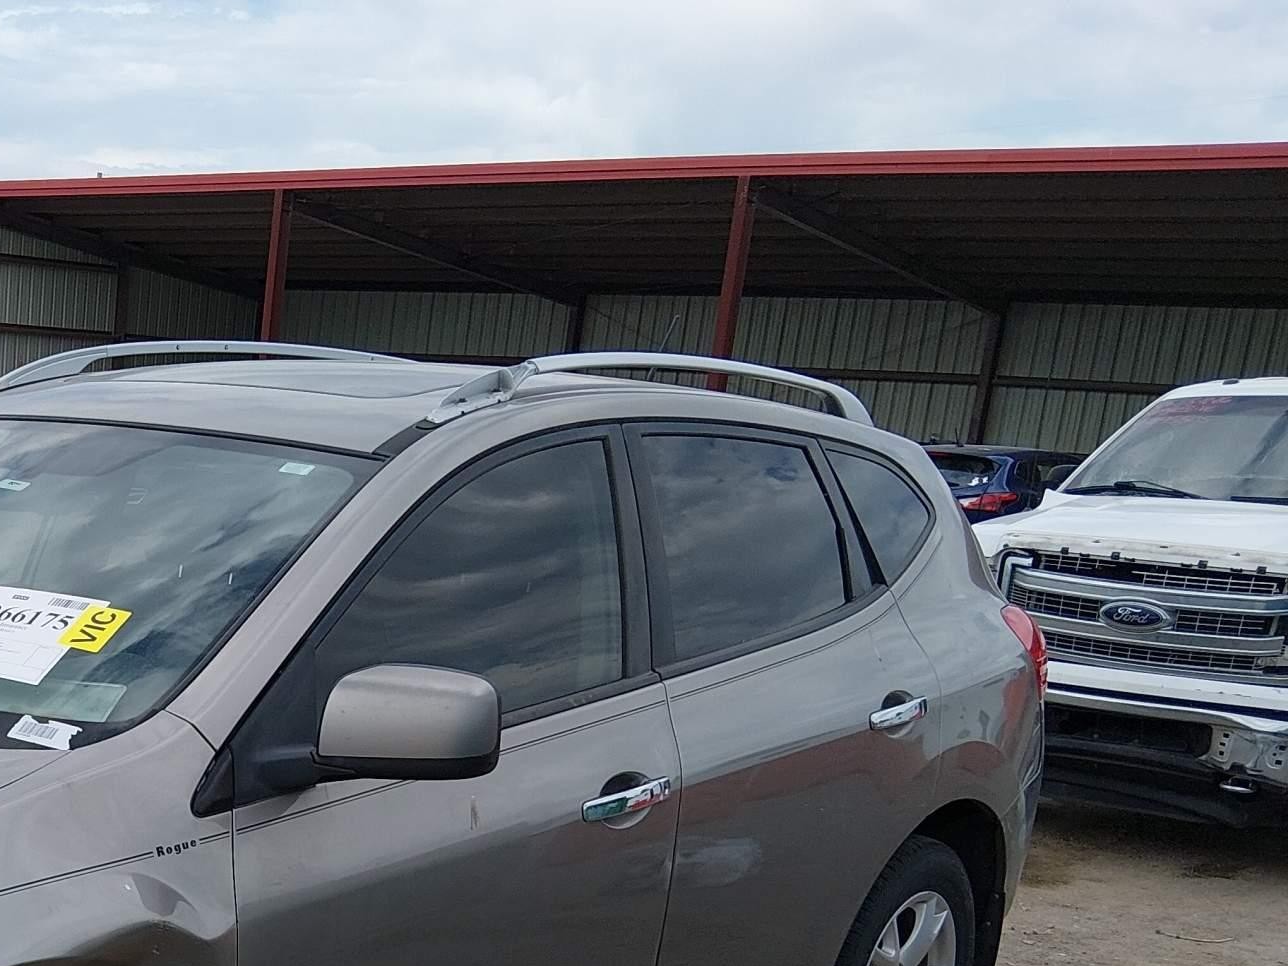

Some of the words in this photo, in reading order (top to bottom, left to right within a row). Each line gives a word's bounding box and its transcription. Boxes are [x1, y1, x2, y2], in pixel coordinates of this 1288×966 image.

[1113, 606, 1149, 623] Ford
[70, 610, 117, 645] VIC
[156, 839, 197, 857] Rogue
